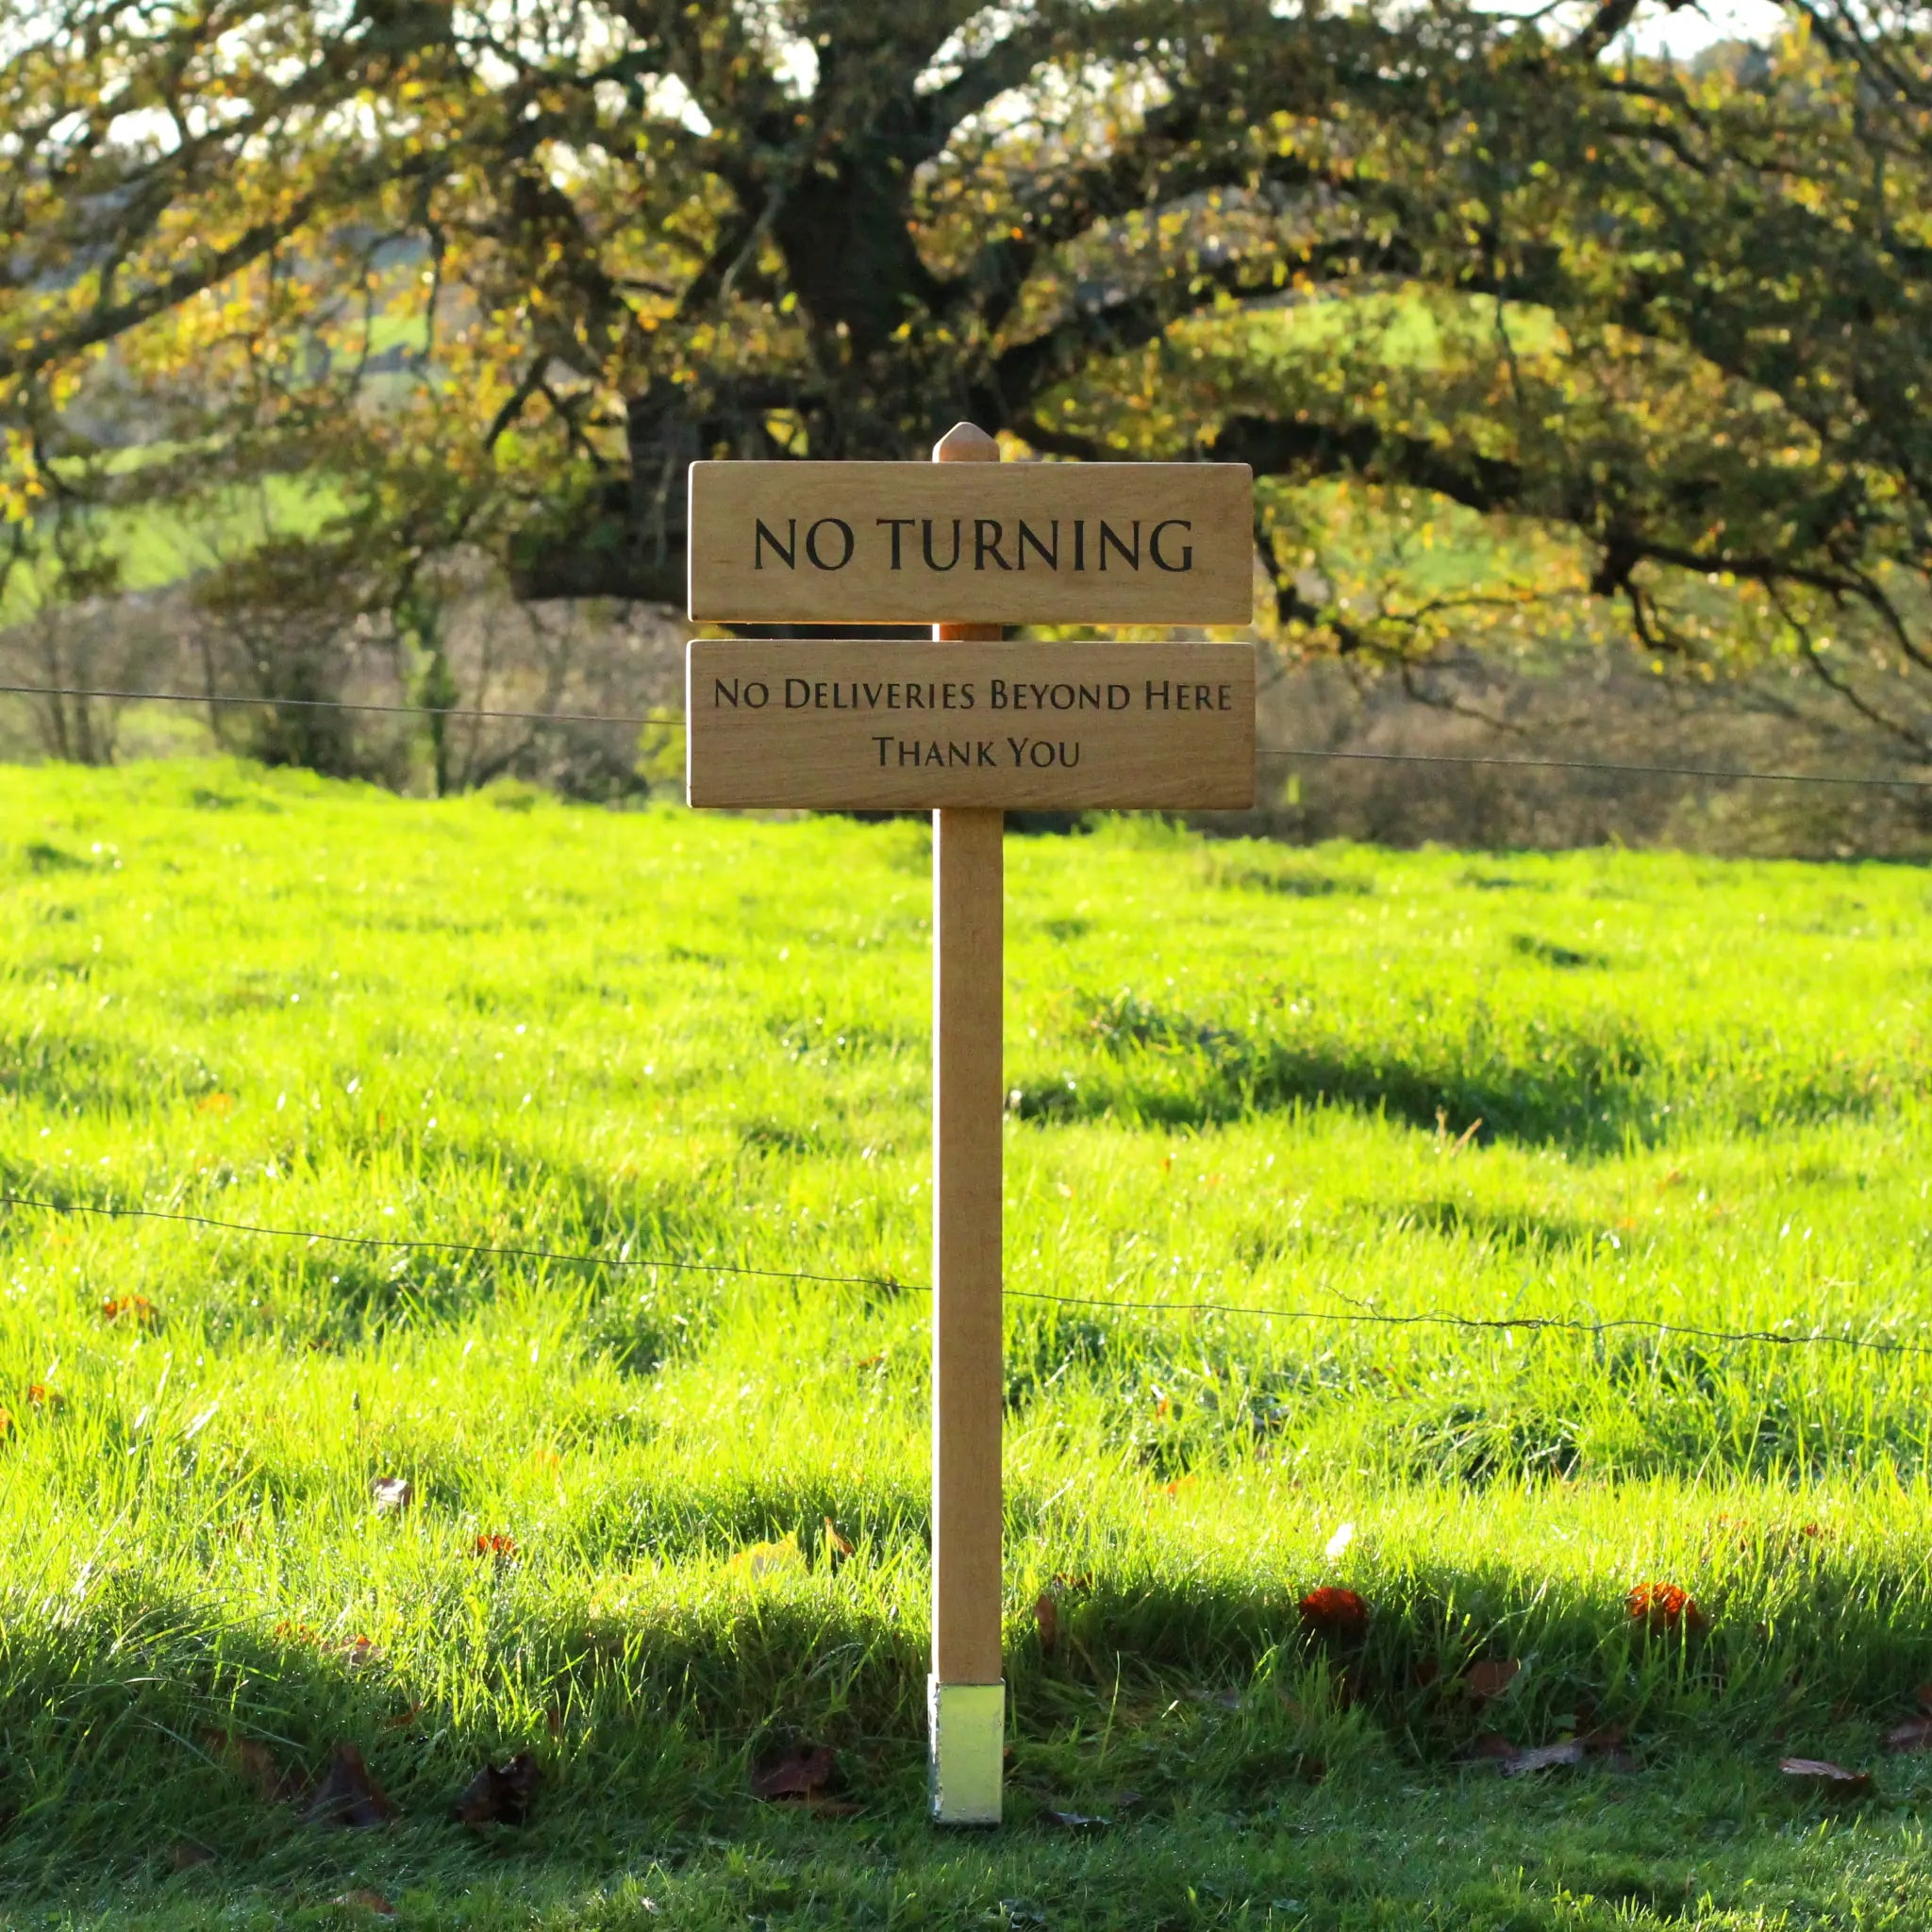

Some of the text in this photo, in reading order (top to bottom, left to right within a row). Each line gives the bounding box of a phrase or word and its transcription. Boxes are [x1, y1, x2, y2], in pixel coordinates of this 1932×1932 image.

[754, 517, 1194, 573] NO TURNING
[714, 677, 1232, 710] NO DELIVERIES BEYOND HERE
[871, 736, 1080, 768] THANK YOU
